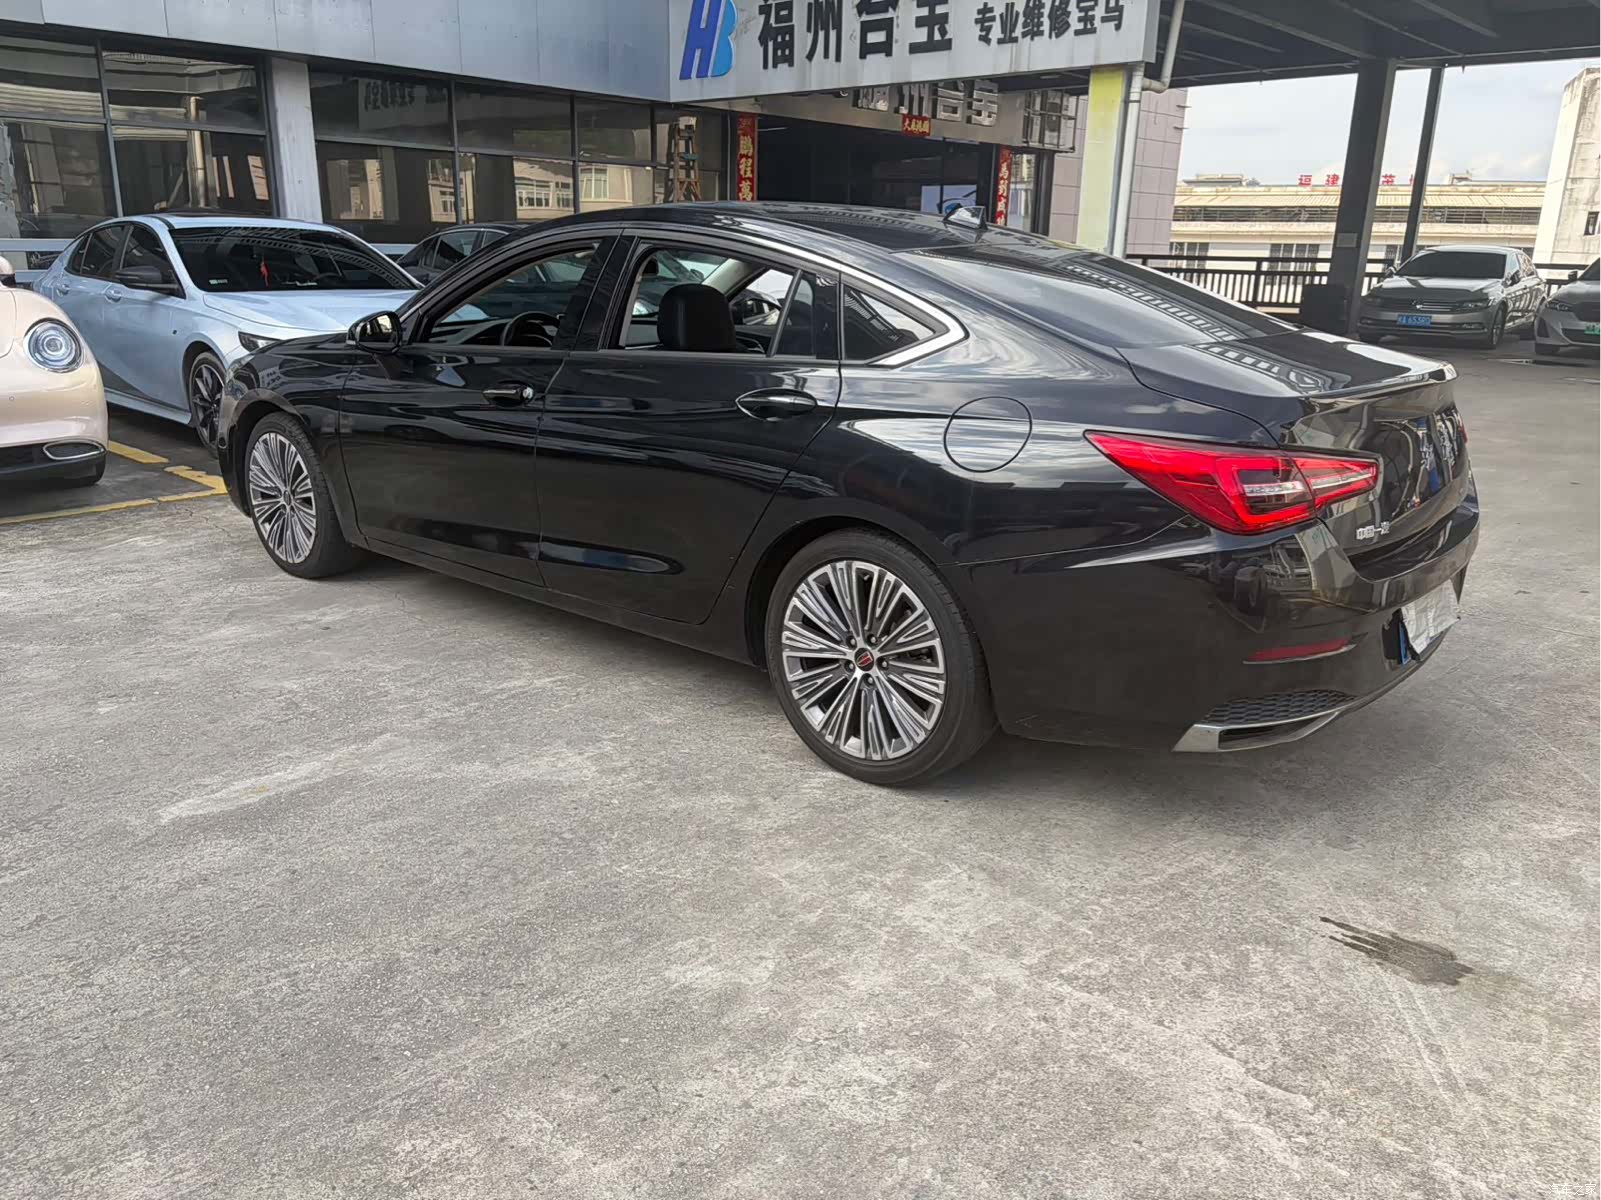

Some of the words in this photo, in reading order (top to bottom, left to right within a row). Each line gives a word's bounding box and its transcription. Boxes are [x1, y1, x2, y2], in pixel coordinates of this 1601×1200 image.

[679, 0, 737, 80] HB
[974, 1, 1125, 46] 专业维修宝马
